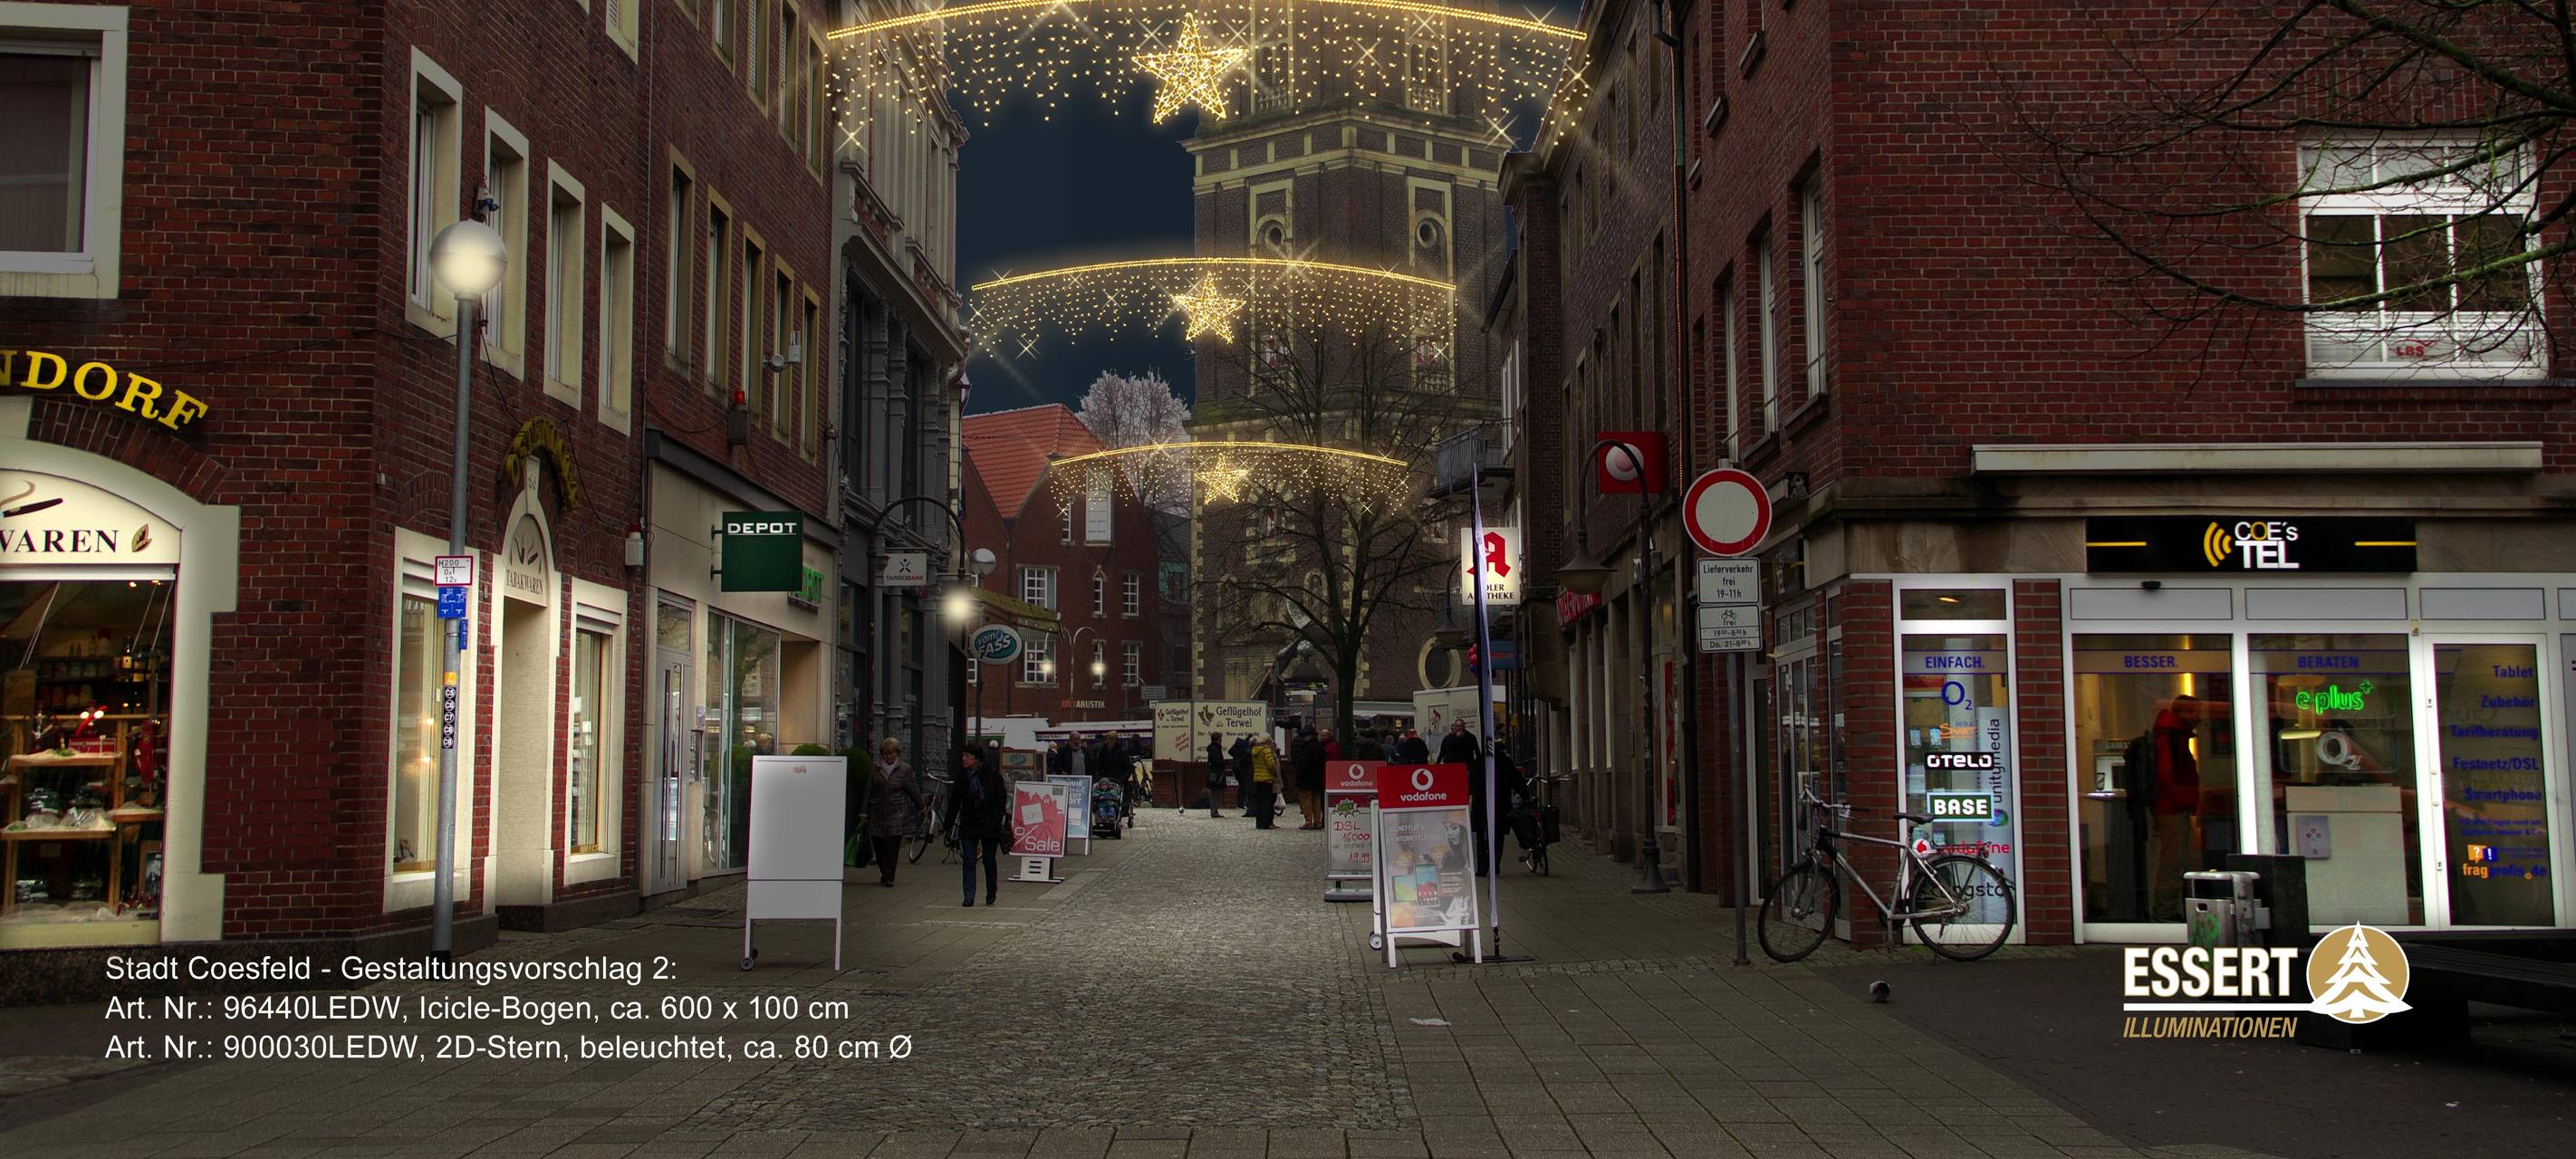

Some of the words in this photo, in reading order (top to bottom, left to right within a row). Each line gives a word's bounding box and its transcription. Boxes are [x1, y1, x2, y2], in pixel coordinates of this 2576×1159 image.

[2397, 346, 2425, 357] LBS
[726, 522, 798, 534] DEPOT
[2235, 541, 2300, 570] TEL
[1703, 564, 1754, 574] Lieferverkehr
[505, 569, 543, 595] TABAKWAREN
[1722, 576, 1736, 586] frei
[1466, 591, 1514, 600] ATHEKE
[1716, 589, 1742, 599] 19-11h
[977, 633, 996, 646] vom
[977, 636, 1012, 659] FASS
[1925, 656, 1985, 669] EINFACH.
[2493, 665, 2534, 678] Tablet
[2480, 694, 2535, 708] Zubehör
[1216, 705, 1263, 718] Geflügelhof
[2450, 724, 2539, 740] Tarifberatung
[1987, 718, 2005, 803] unitymedia
[2452, 757, 2540, 771] Festnetz/DSL
[1340, 780, 1374, 788] vodafone
[1399, 790, 1448, 802] vodafone
[2464, 788, 2542, 803] Smartphone
[1934, 799, 1988, 815] BASE
[1333, 820, 1362, 831] DSL
[1024, 835, 1061, 852] Sale
